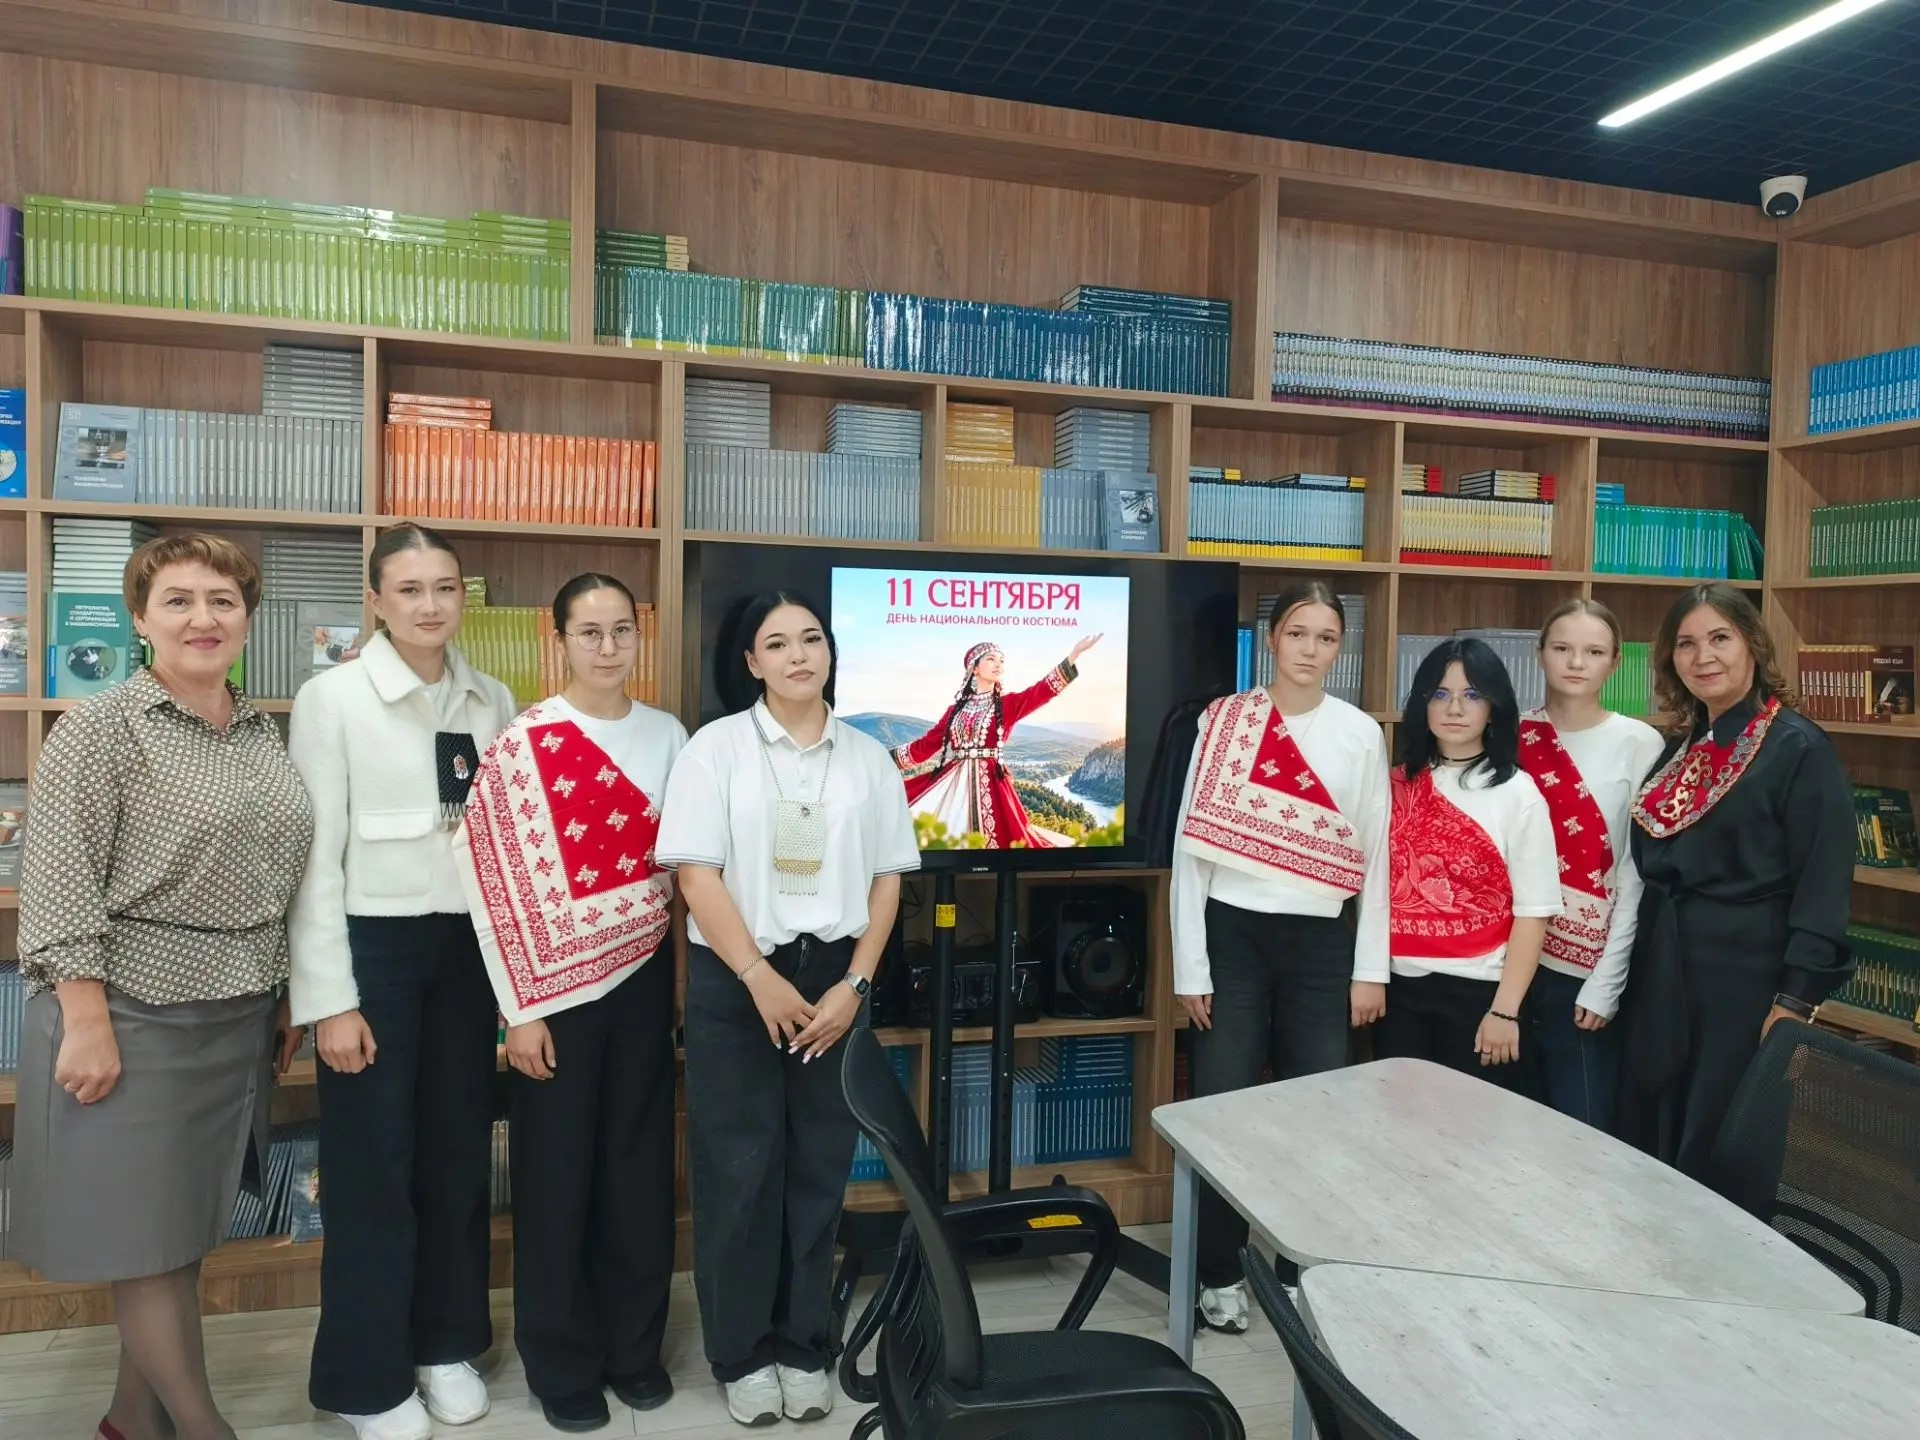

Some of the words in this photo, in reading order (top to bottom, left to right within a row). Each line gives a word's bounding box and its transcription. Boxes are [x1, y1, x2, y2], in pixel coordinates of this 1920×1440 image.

[887, 577, 912, 608] 11
[928, 579, 1080, 610] СЕНТЯБРЯ
[886, 613, 917, 625] ДЕНЬ
[920, 614, 1020, 626] НАЦИОНАЛЬНОГО
[1023, 616, 1078, 627] КОСТЮМА
